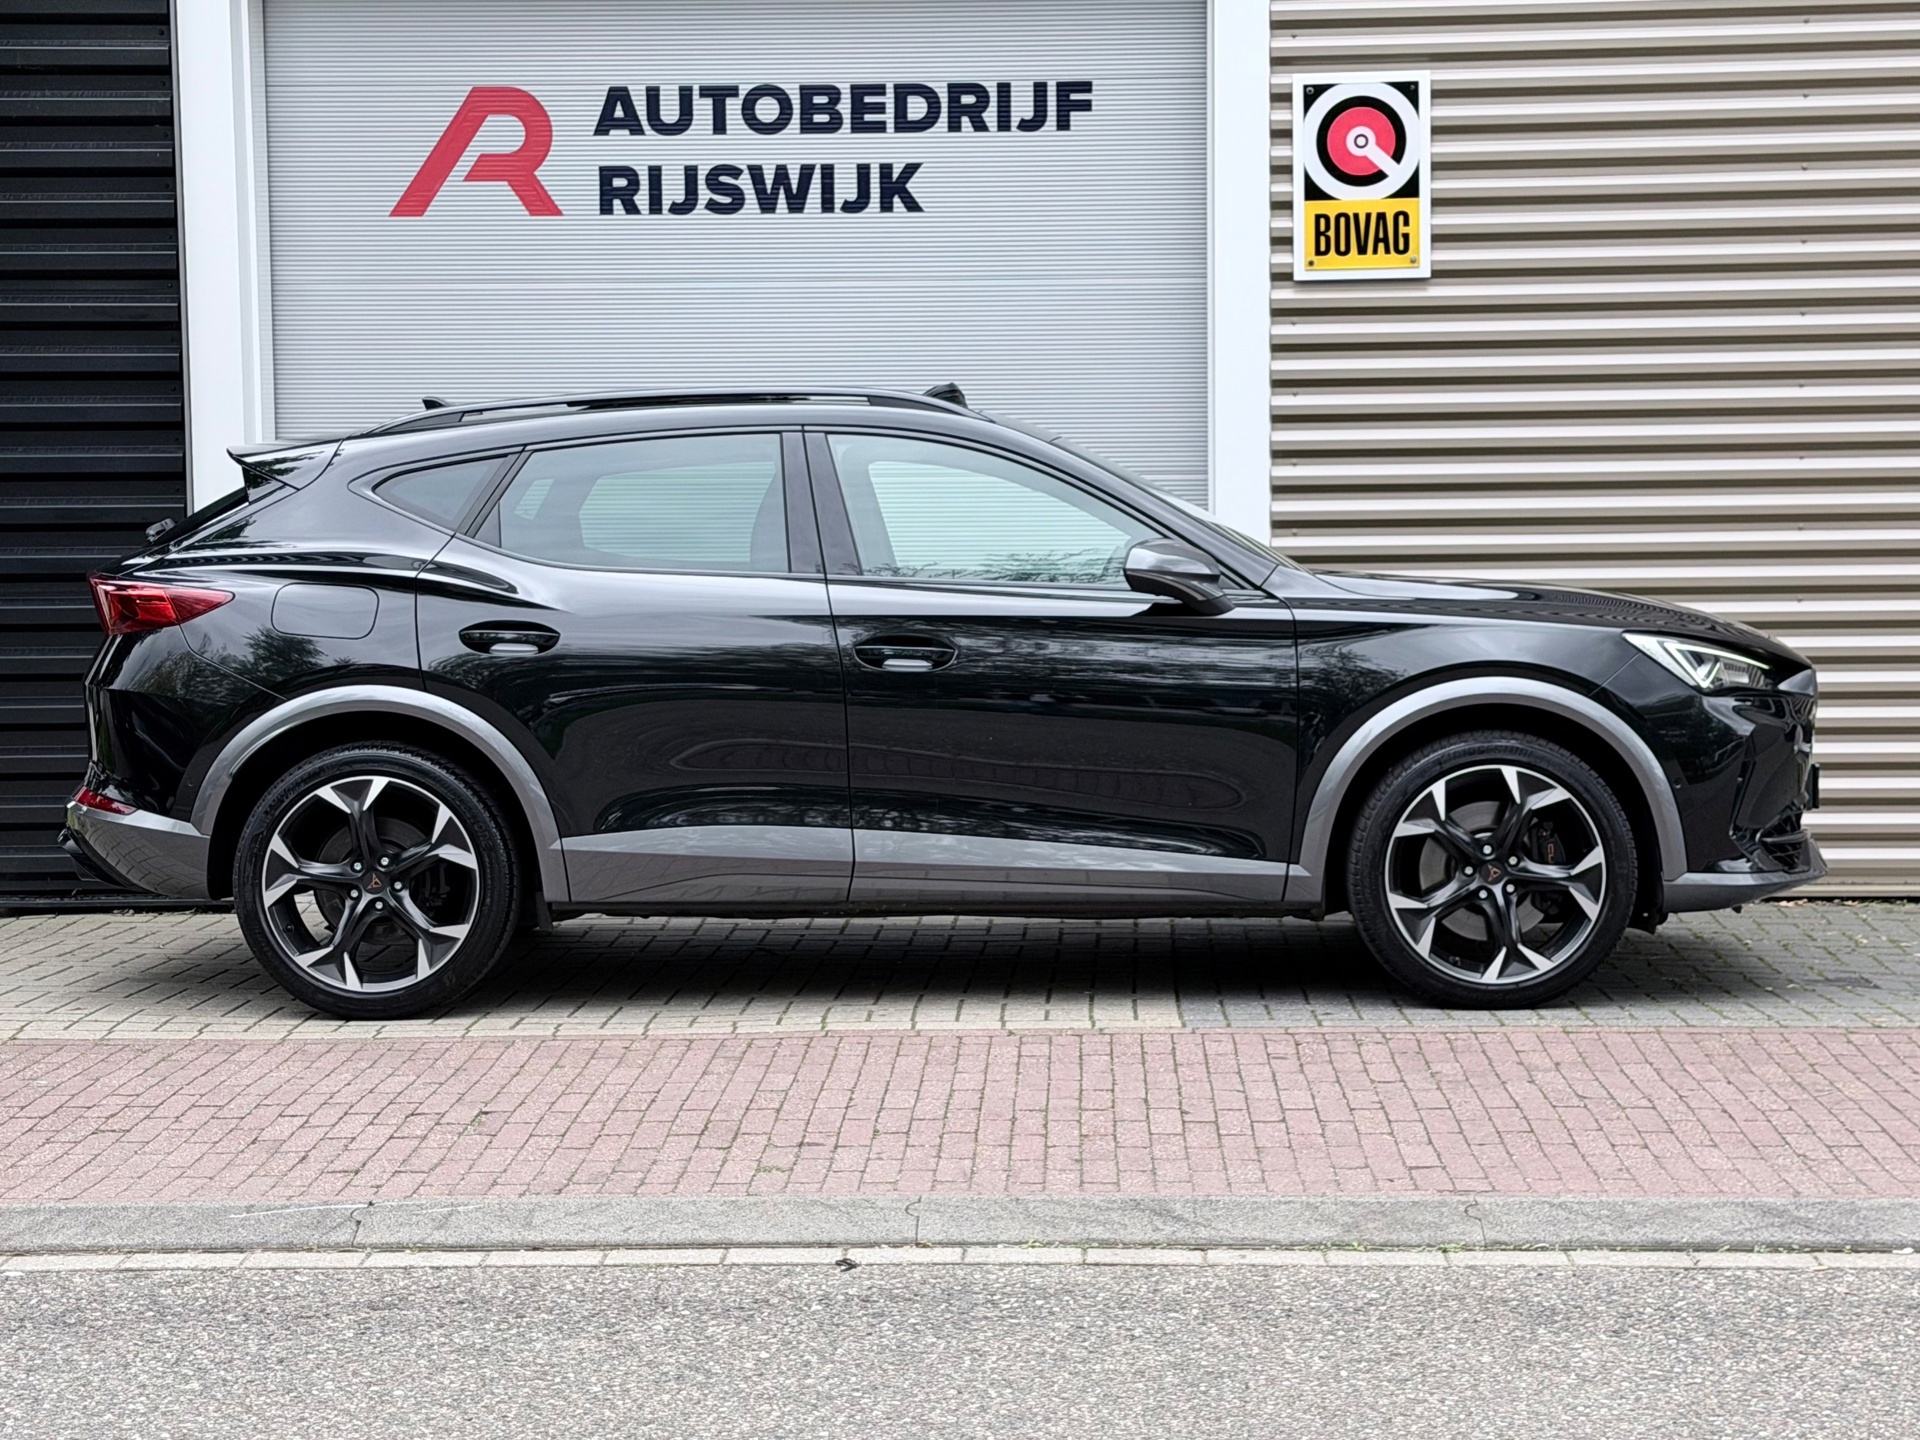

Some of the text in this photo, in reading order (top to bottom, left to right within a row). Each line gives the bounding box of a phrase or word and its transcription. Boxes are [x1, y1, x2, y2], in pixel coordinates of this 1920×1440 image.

[594, 80, 1092, 136] AUTOBEDRIJF
[598, 162, 924, 216] RIJSWIJK
[1314, 210, 1411, 257] BOVAG
